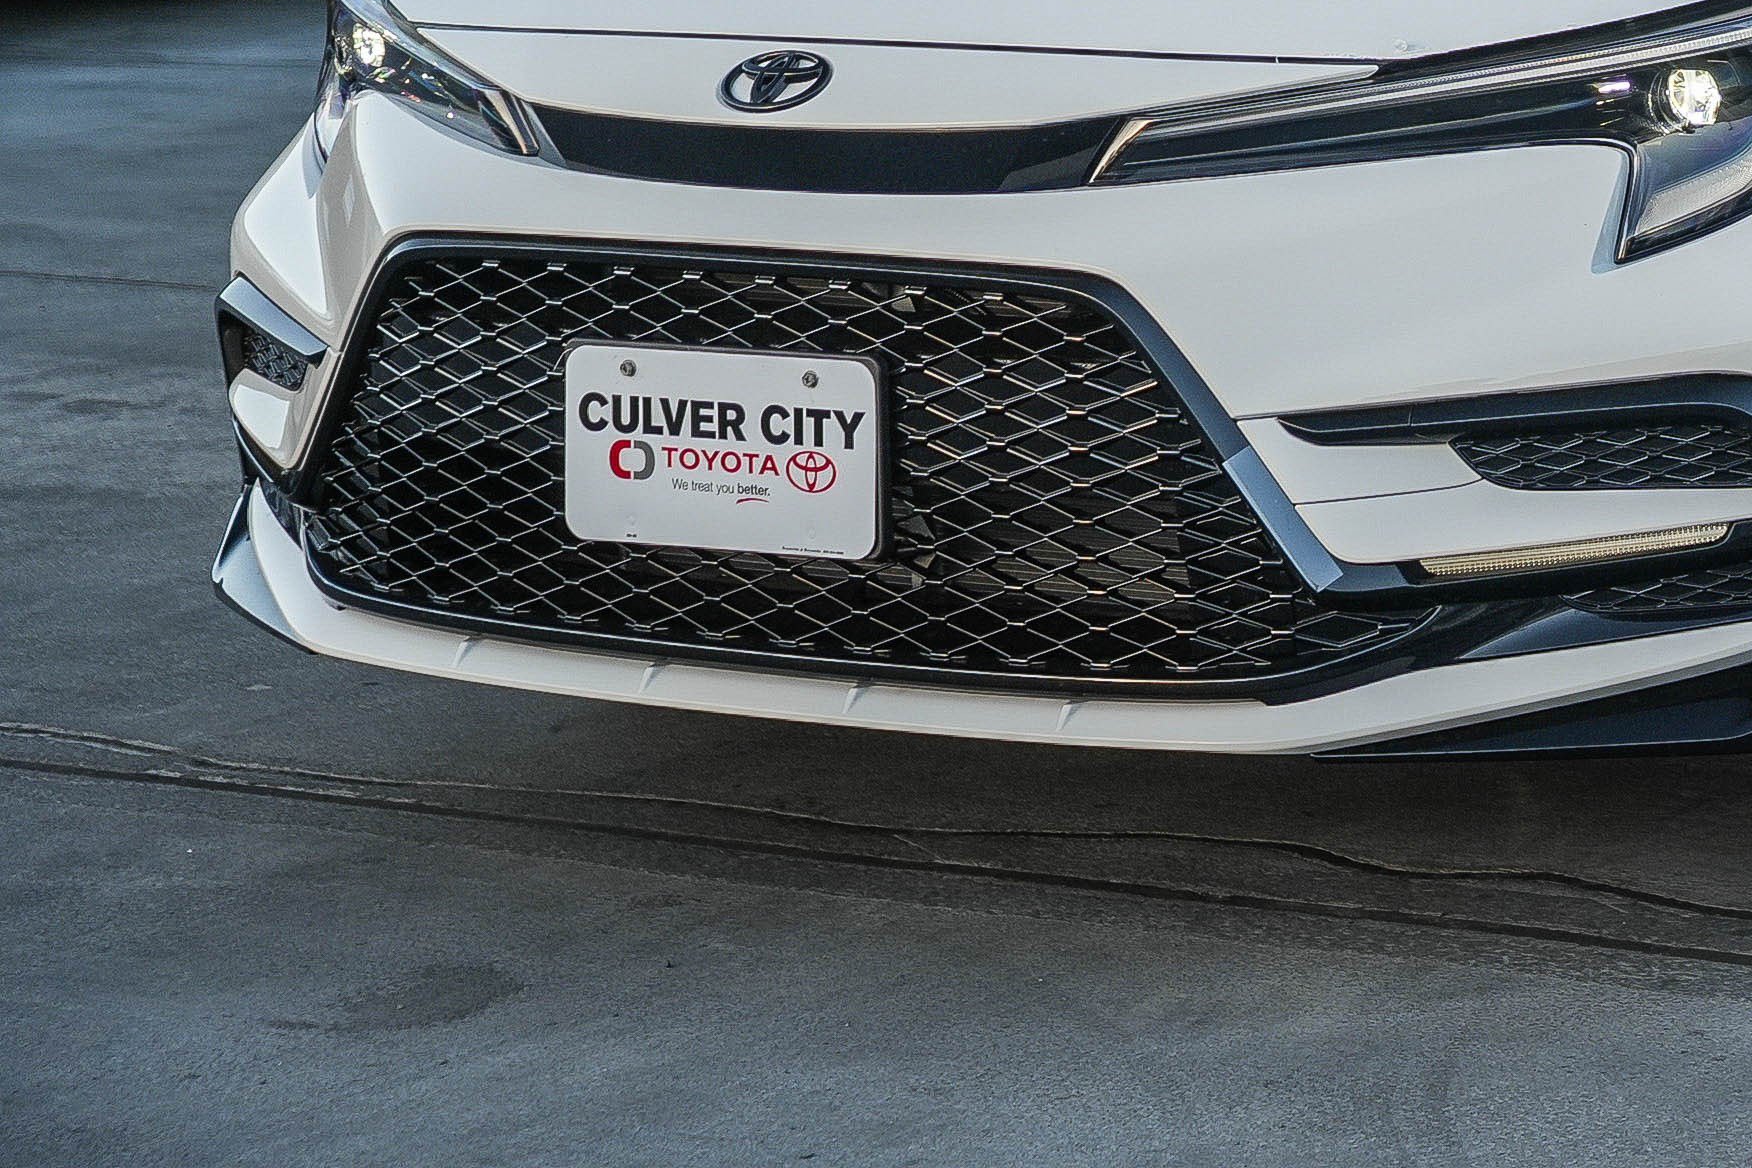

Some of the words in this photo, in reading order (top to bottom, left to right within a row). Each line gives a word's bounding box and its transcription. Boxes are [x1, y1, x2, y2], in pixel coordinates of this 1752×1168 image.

[578, 392, 747, 442] CULVER
[760, 404, 866, 450] CITY
[662, 446, 780, 476] TOYOTA
[672, 478, 689, 491] We
[691, 480, 713, 492] treat
[716, 484, 735, 496] you
[737, 483, 770, 497] better.
